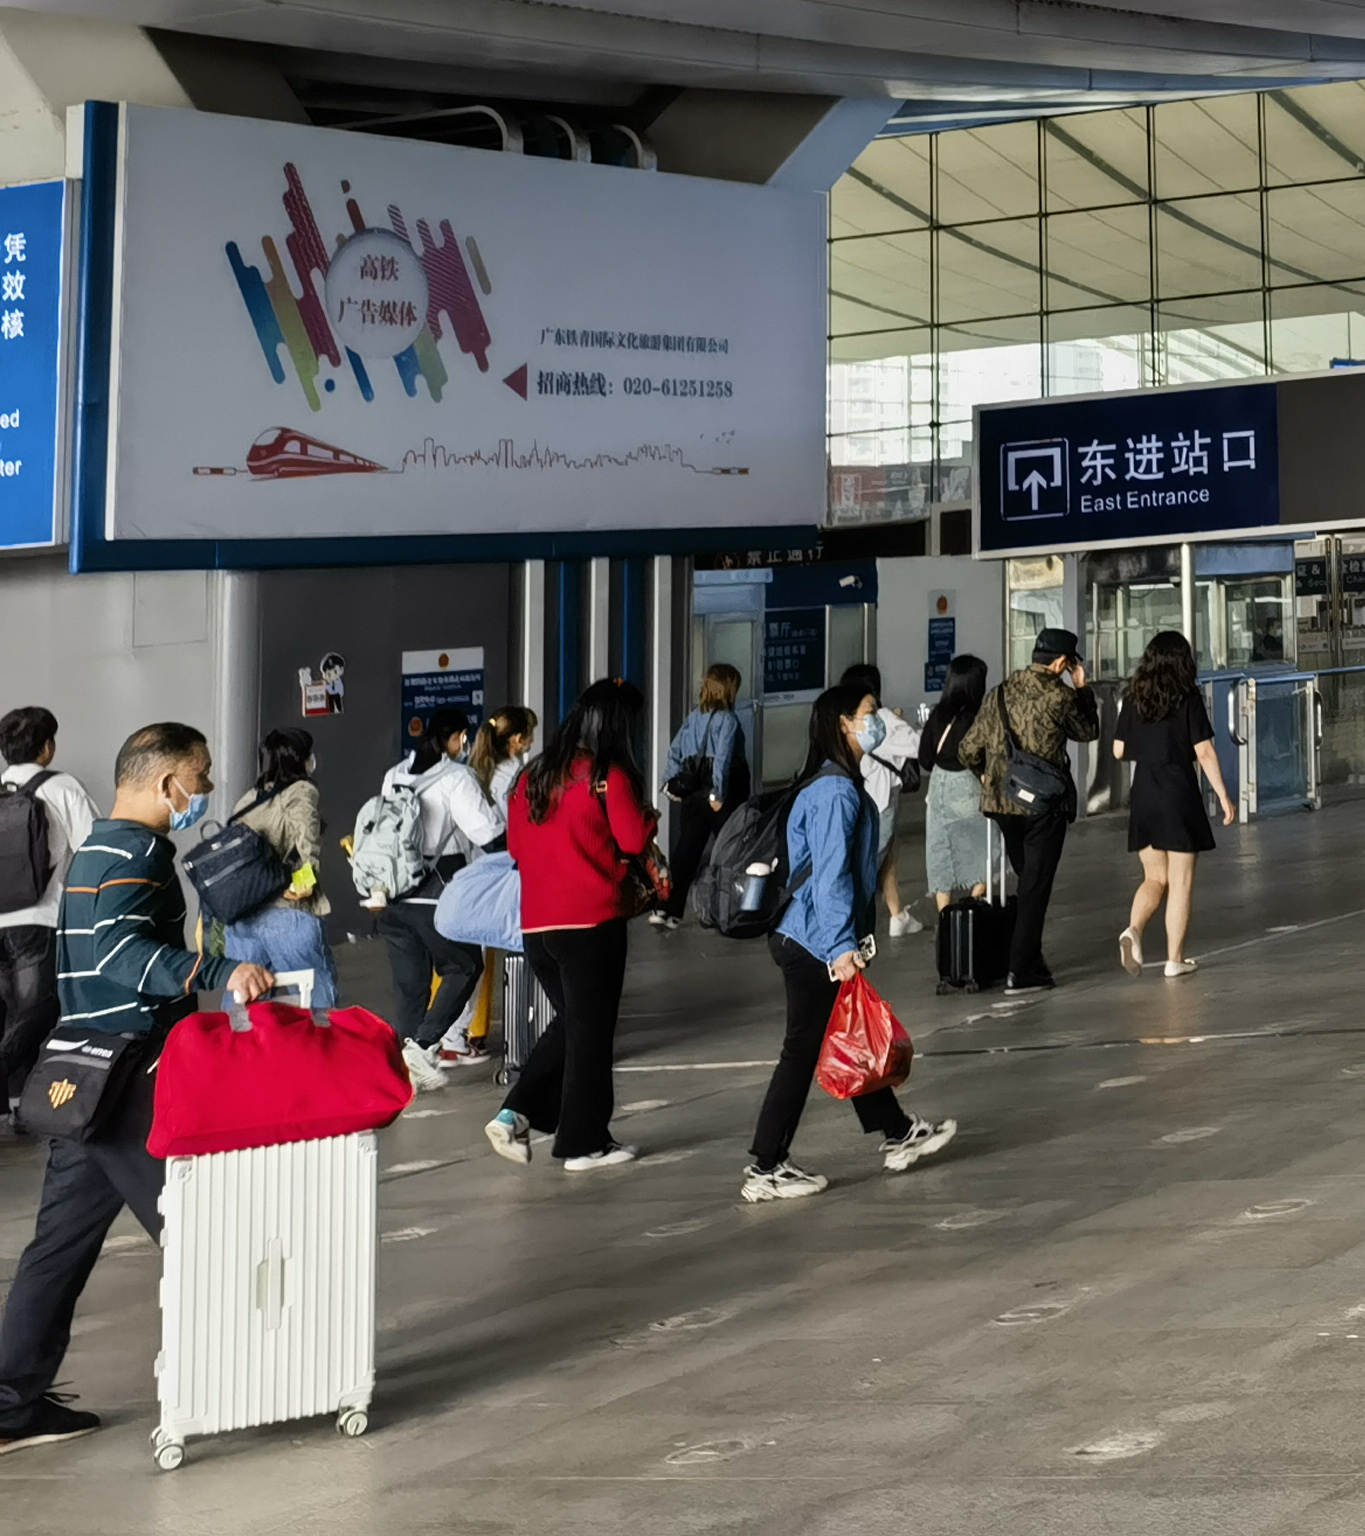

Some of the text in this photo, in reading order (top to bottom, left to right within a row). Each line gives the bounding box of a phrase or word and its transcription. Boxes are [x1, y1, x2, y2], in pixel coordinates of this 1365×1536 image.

[360, 254, 400, 282] 高铁
[338, 295, 418, 328] 广告媒体
[1077, 429, 1256, 486] 东进站口
[1081, 486, 1210, 513] East Entrance
